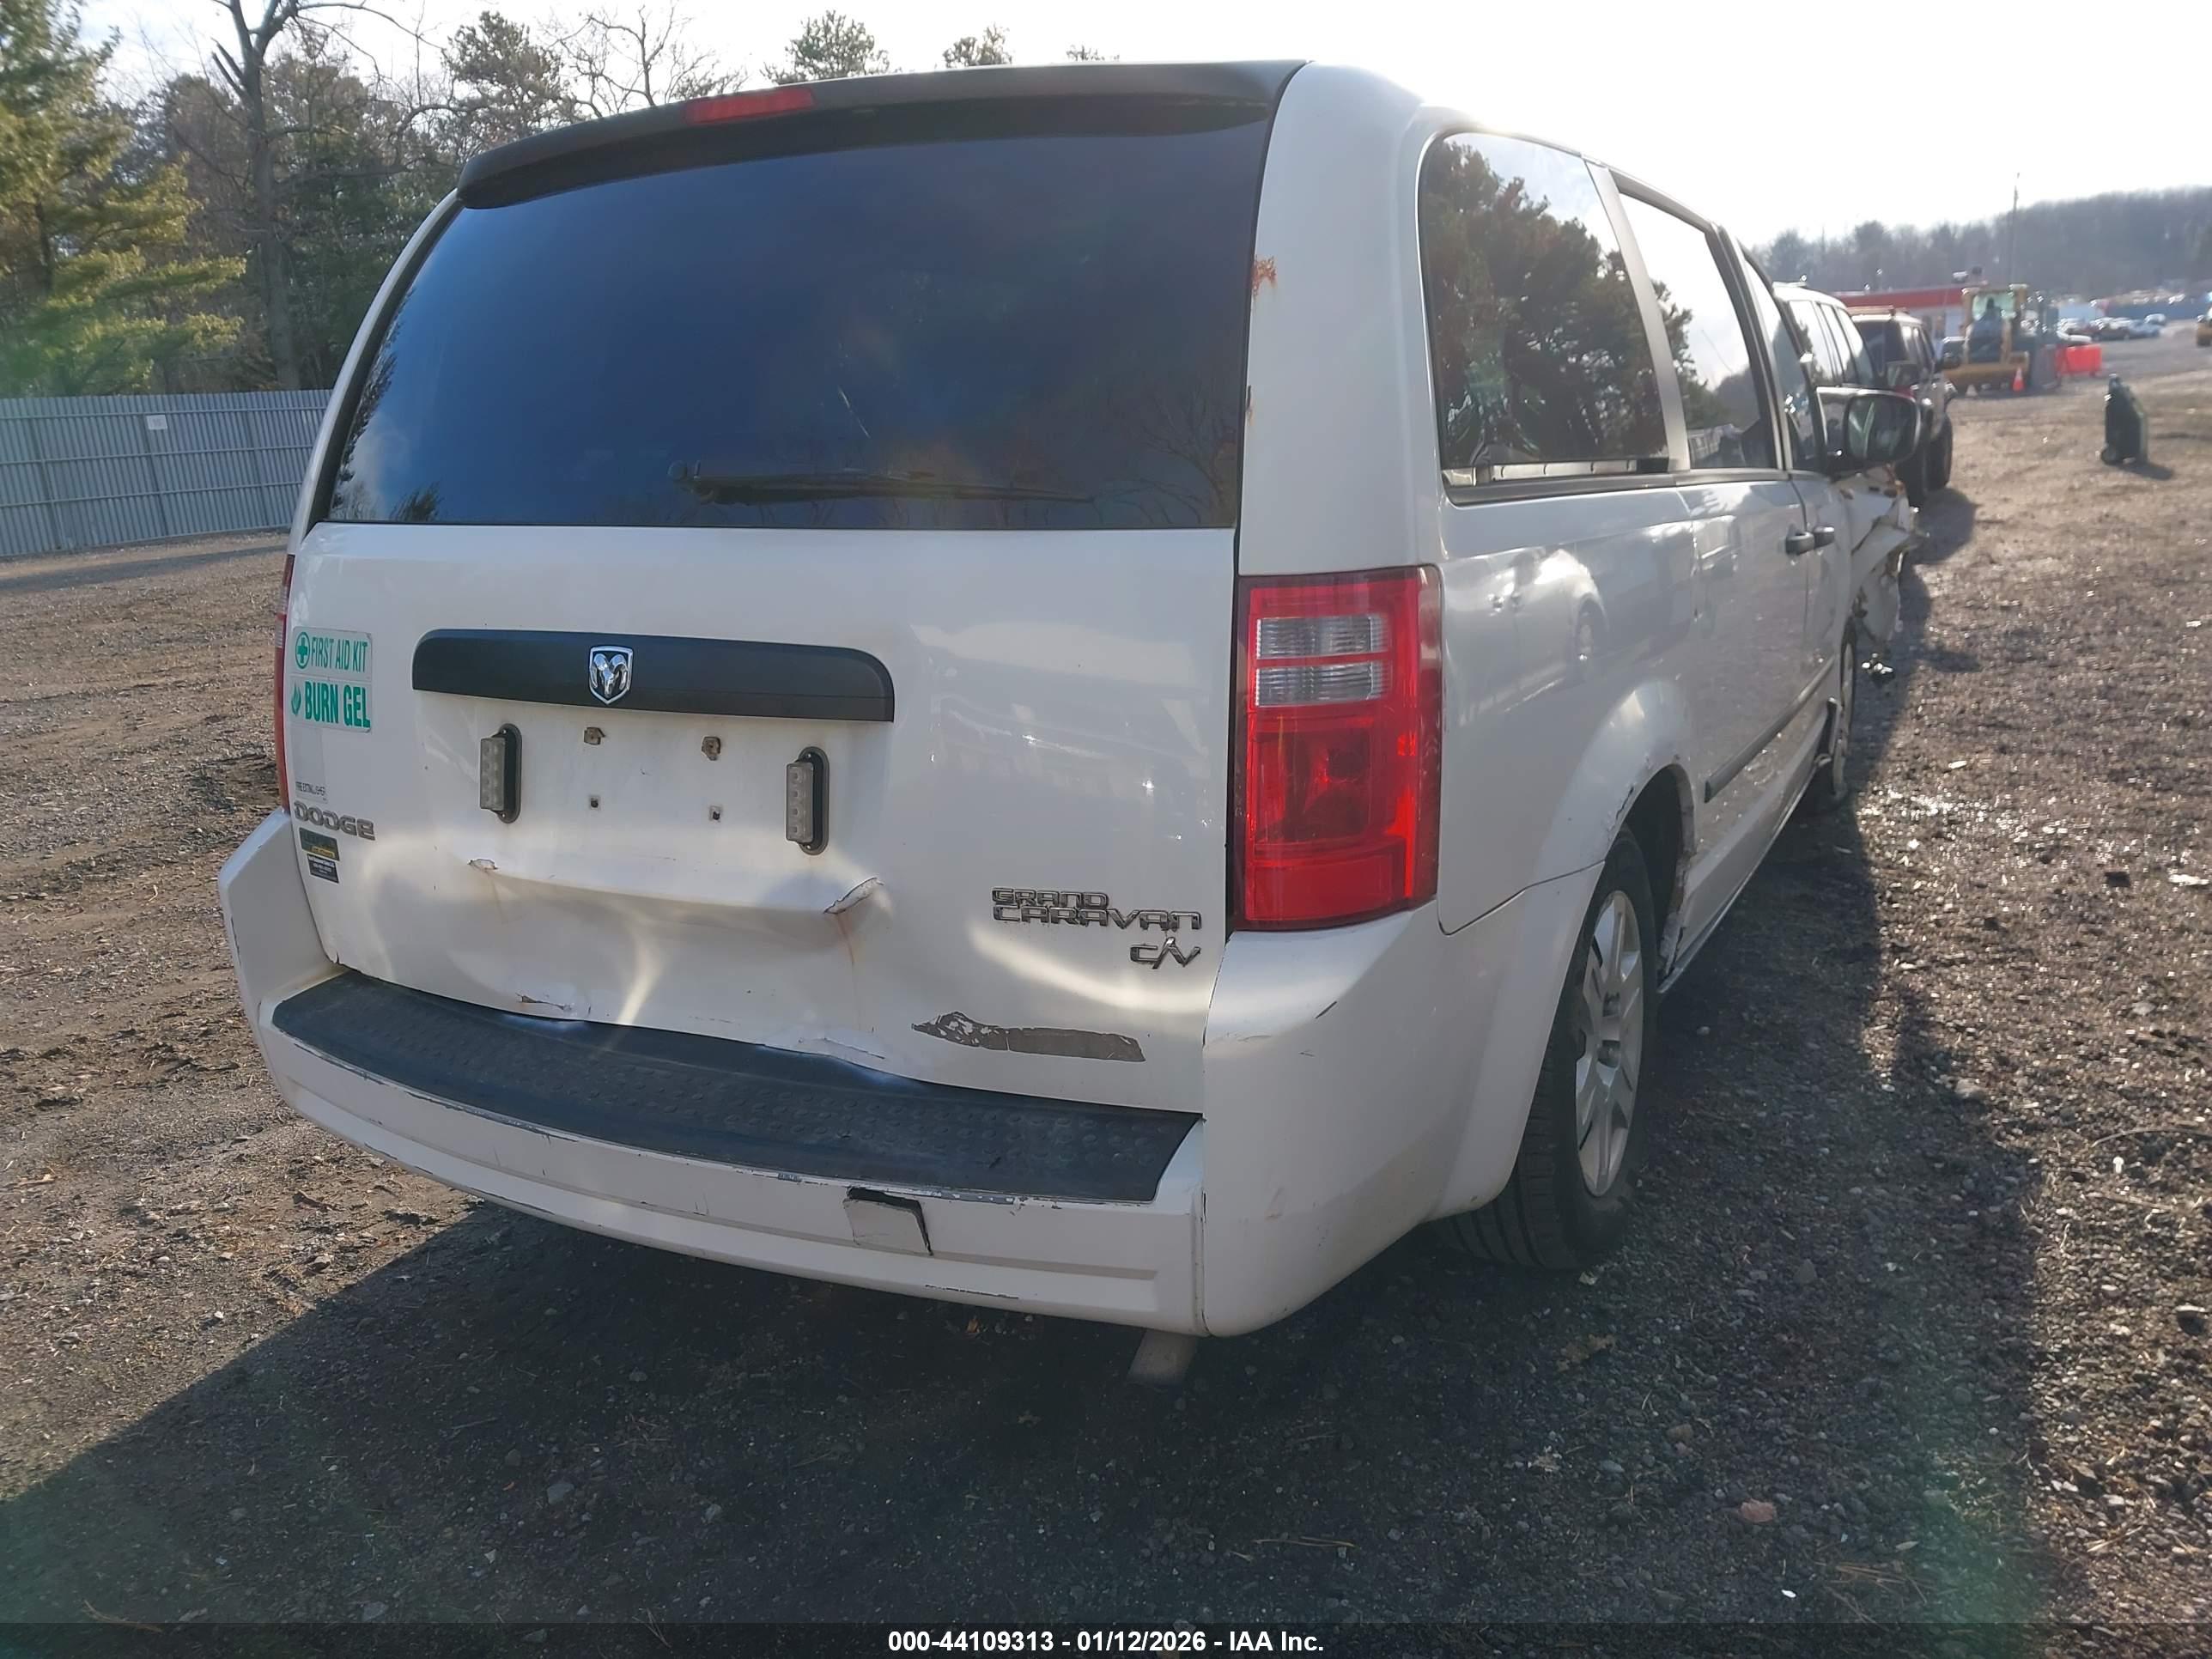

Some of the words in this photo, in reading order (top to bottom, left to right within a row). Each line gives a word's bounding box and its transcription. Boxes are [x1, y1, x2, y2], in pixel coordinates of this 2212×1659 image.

[311, 636, 334, 669] FIRST
[335, 639, 350, 670] AID
[353, 641, 368, 672] KIT
[305, 681, 339, 724] BURN
[343, 684, 371, 728] GEL
[294, 800, 375, 841] DODGE
[992, 887, 1109, 910] GRAND
[993, 904, 1202, 933] CARAVAN
